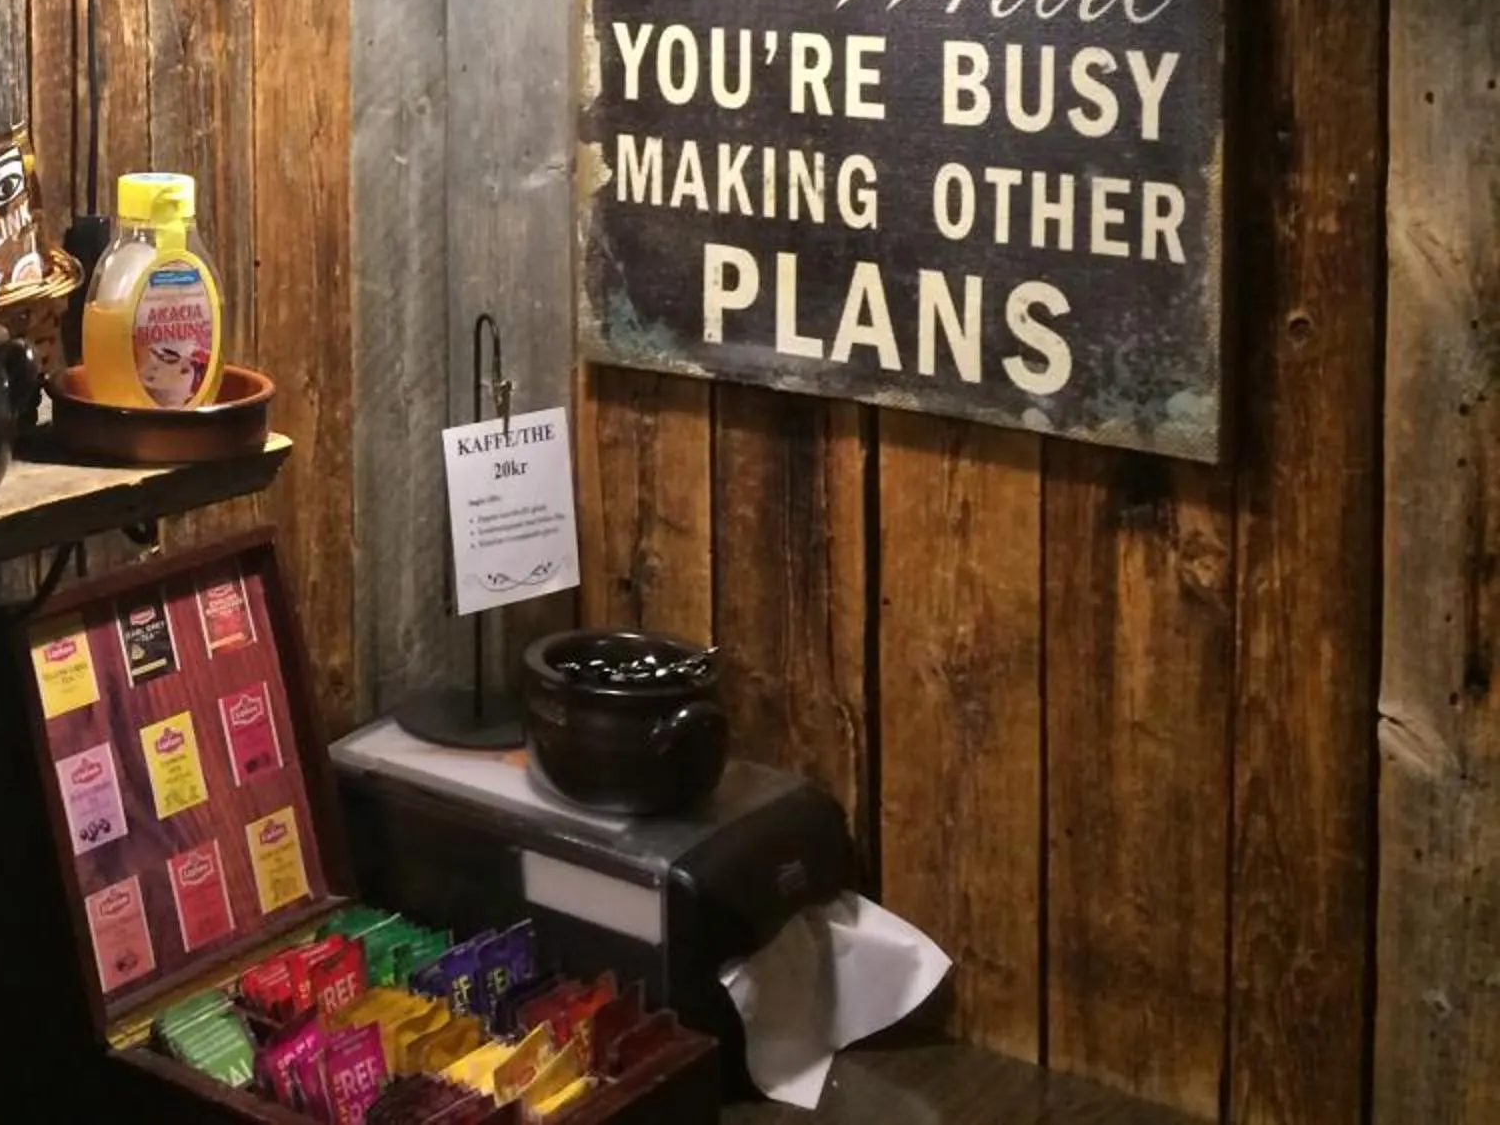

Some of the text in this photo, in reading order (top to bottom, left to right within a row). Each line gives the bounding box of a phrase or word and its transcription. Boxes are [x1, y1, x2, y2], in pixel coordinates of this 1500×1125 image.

[613, 22, 1179, 141] YOU'RE BUSY
[616, 134, 1185, 264] MAKING OTHER
[704, 243, 1072, 395] PLANS
